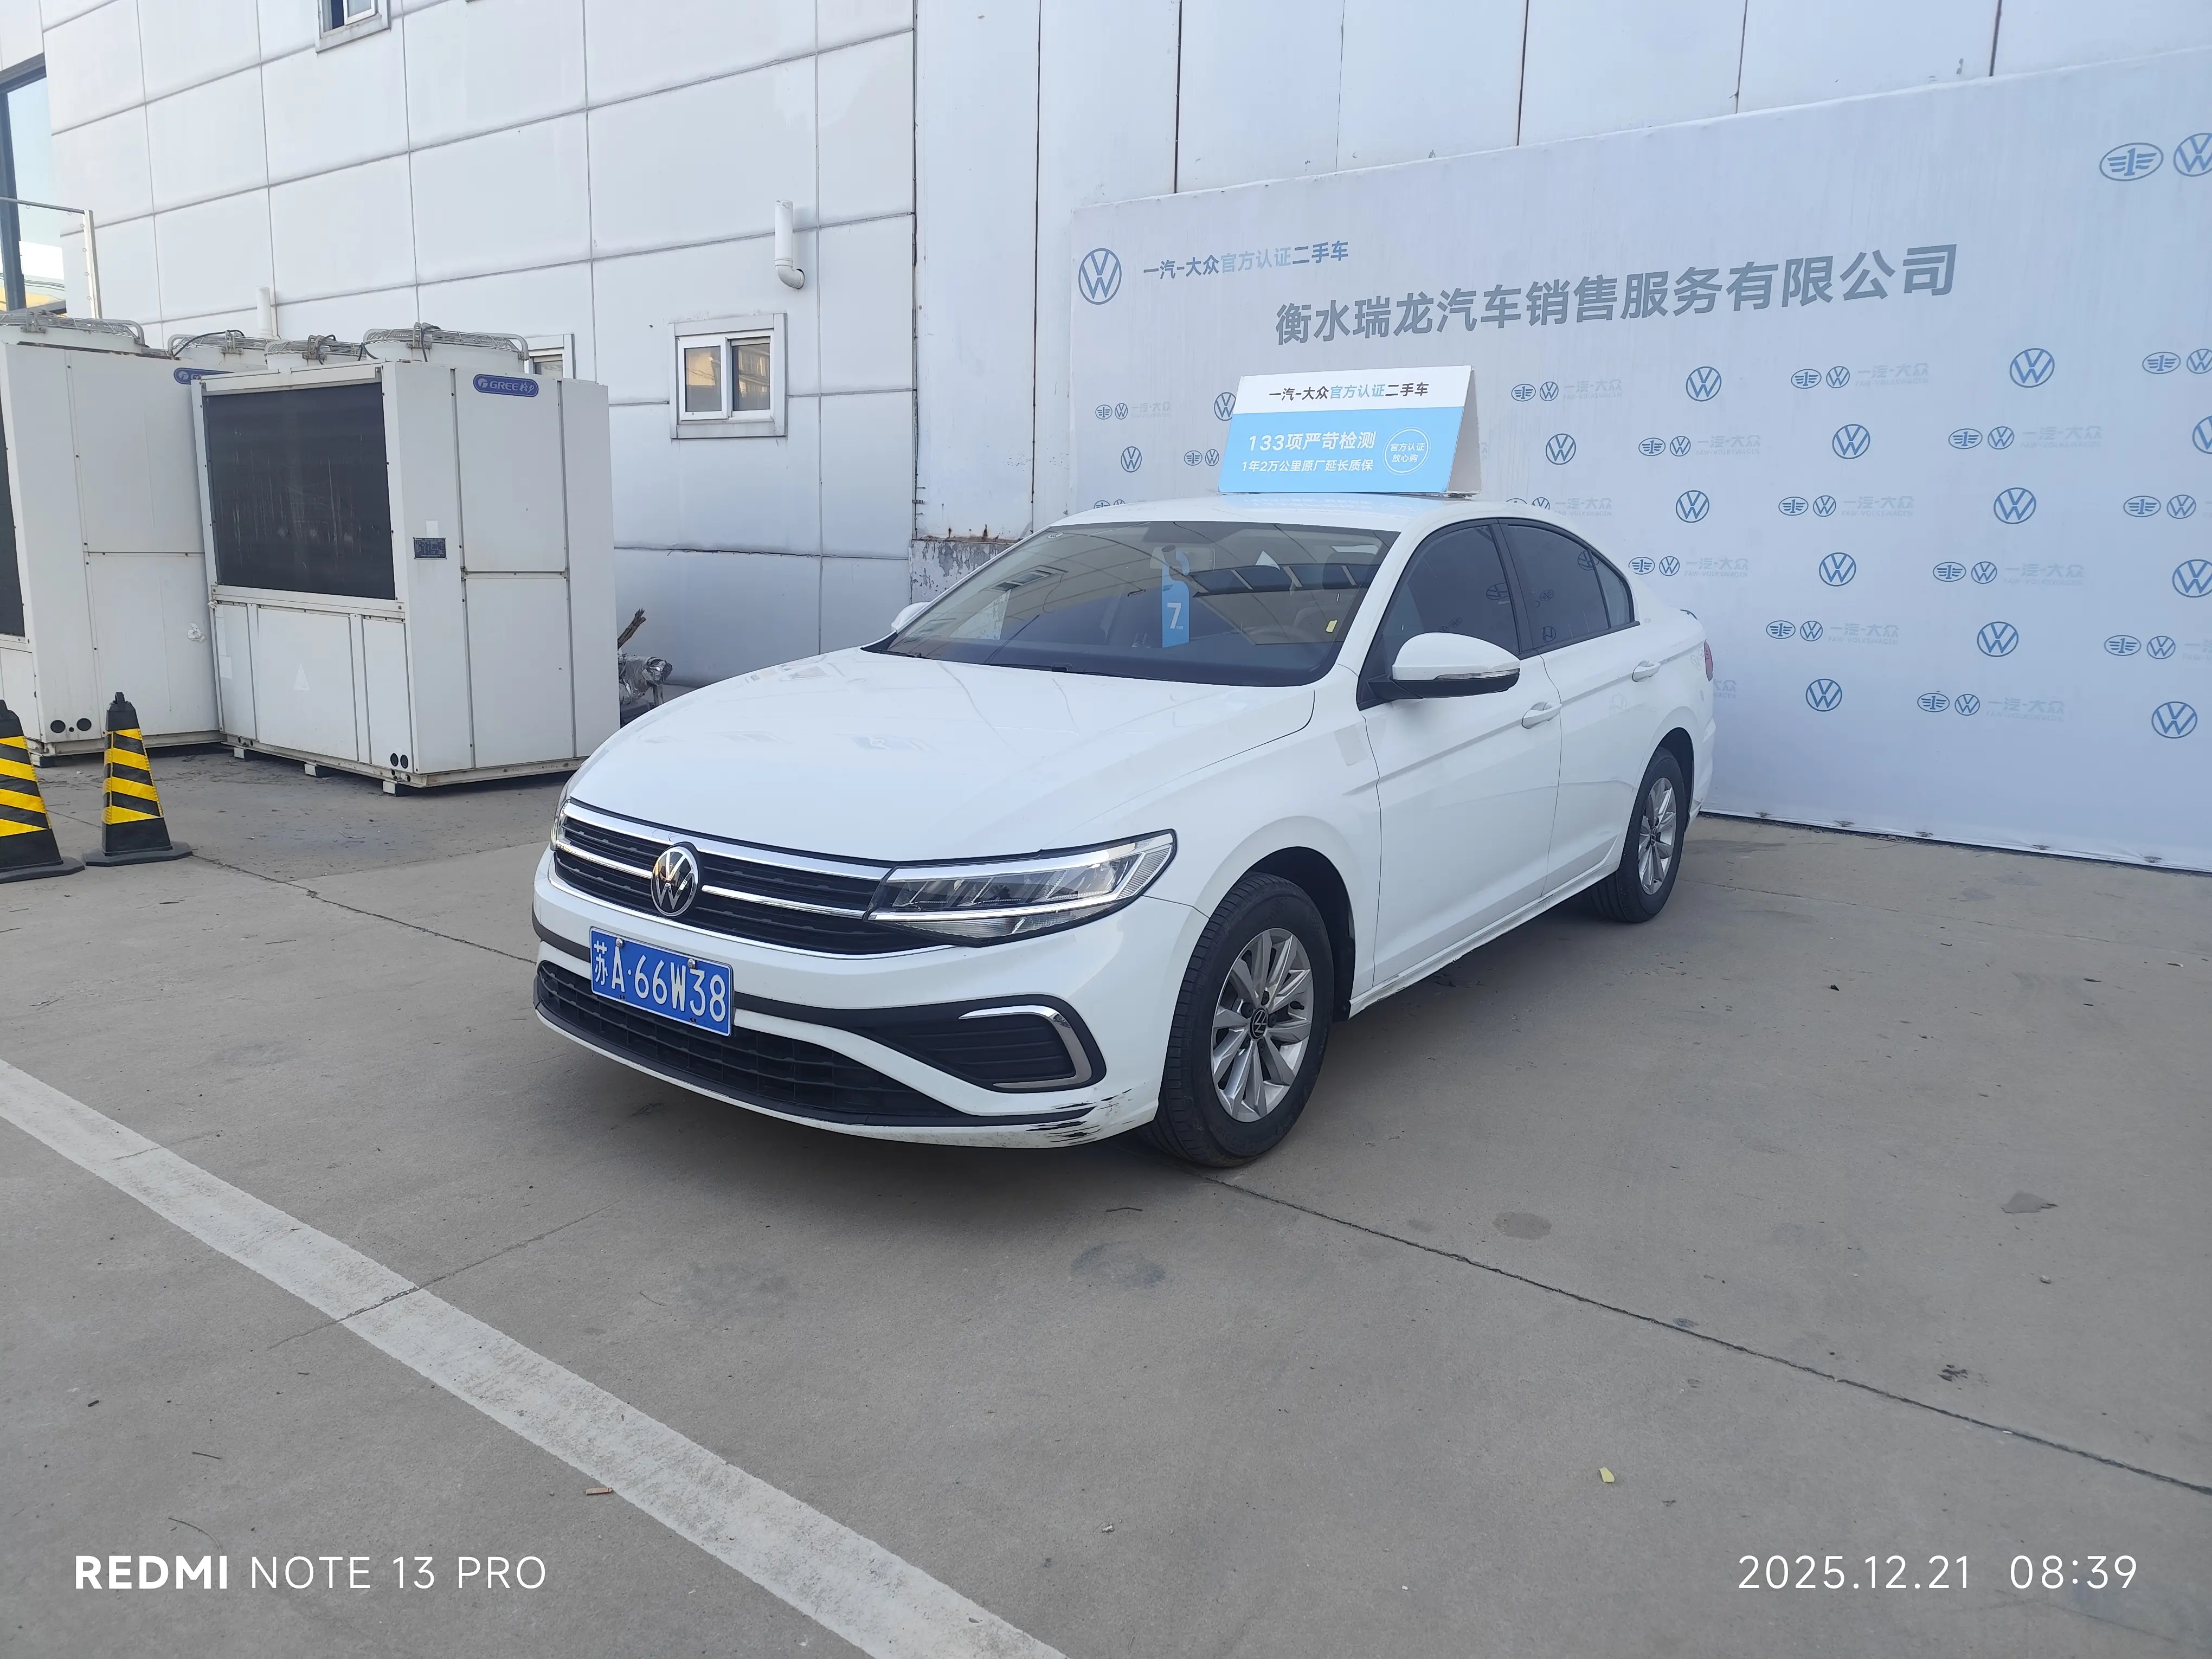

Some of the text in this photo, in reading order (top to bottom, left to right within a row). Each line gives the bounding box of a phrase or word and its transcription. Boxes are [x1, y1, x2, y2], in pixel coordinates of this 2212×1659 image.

[1276, 241, 1957, 345] 衡水瑞龙汽车销售服务有限公司
[490, 381, 518, 390] GREE
[1249, 432, 1377, 451] 133项严苛检测
[1390, 442, 1425, 452] 官方认证
[1392, 454, 1418, 462] 放心购
[1242, 459, 1374, 472] 1年2万公里原厂延长质保
[1167, 602, 1181, 629] 7
